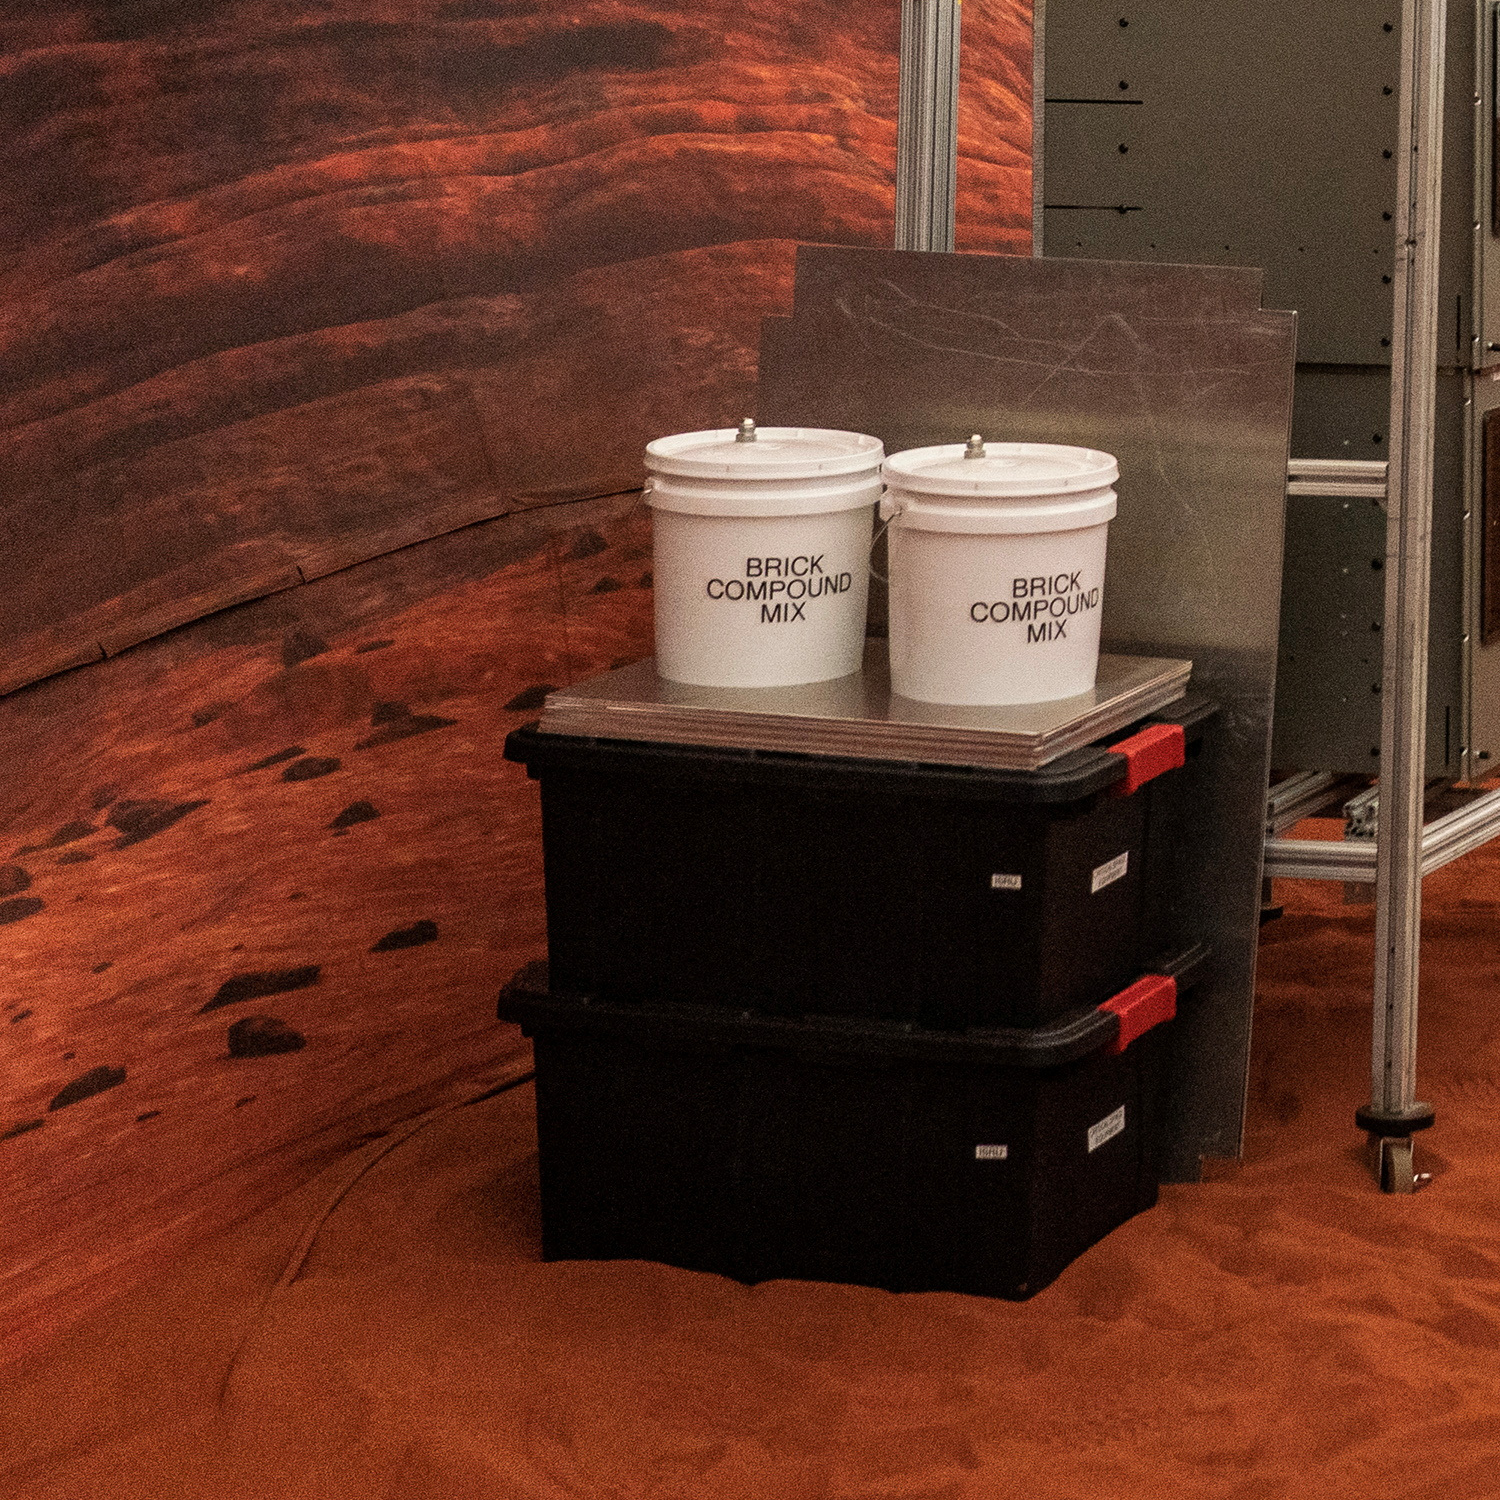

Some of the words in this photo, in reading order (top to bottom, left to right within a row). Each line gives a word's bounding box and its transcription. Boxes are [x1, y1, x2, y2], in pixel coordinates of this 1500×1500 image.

[746, 555, 823, 578] BRICK
[707, 572, 852, 600] COMPOUND
[1012, 571, 1082, 599] BRICK
[760, 602, 806, 624] MIX
[970, 588, 1099, 623] COMPOUND
[1026, 620, 1067, 644] MIX
